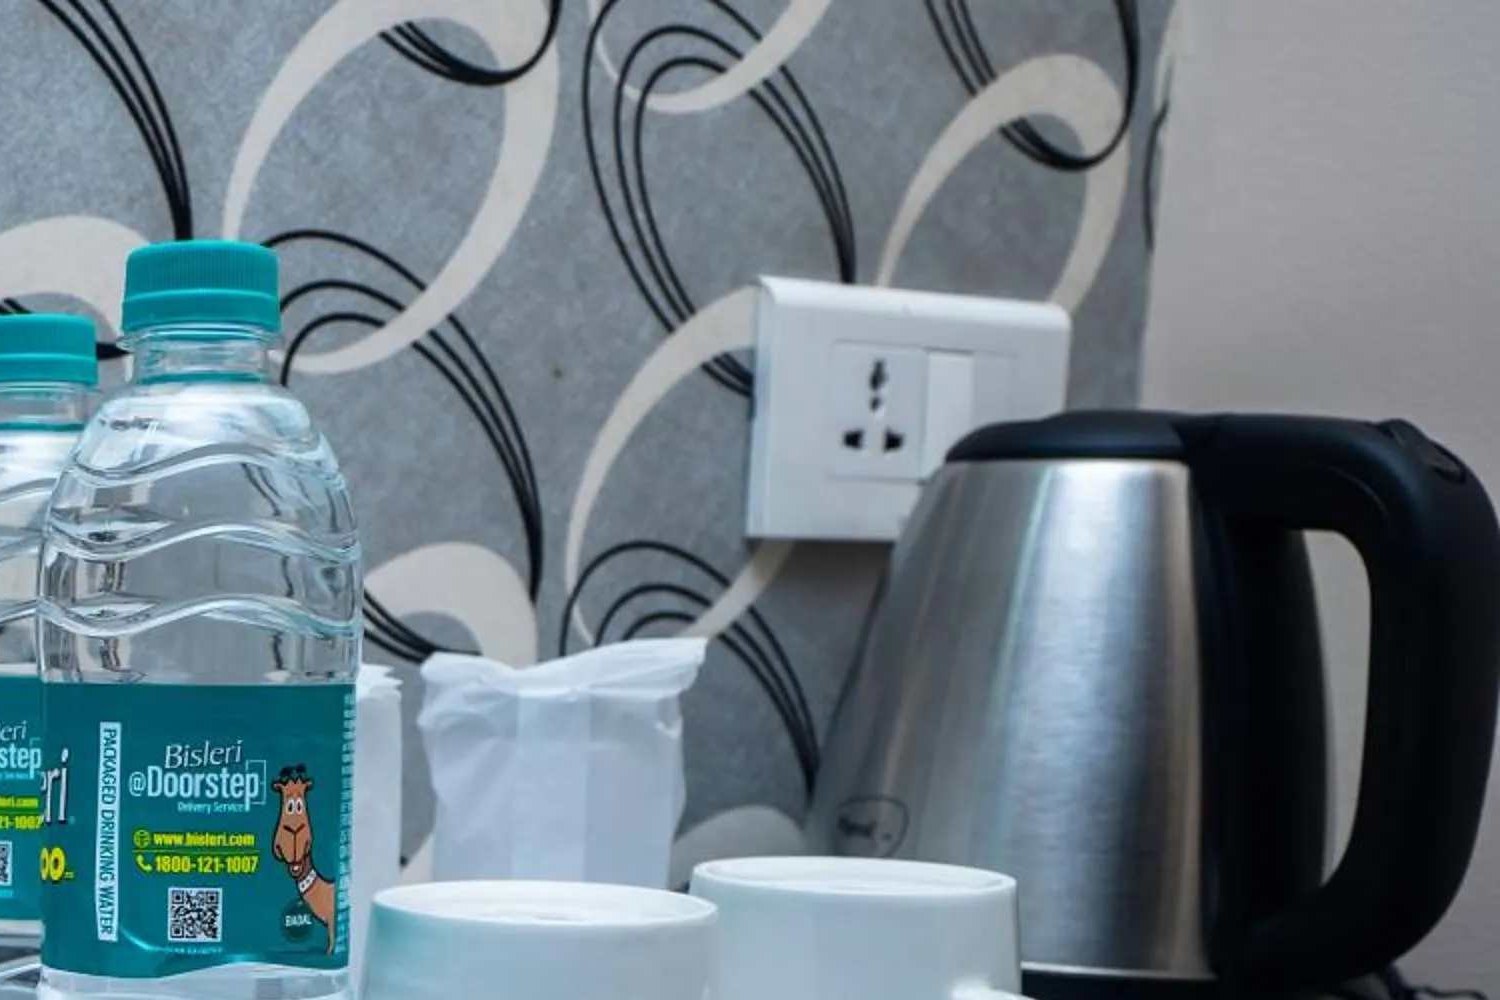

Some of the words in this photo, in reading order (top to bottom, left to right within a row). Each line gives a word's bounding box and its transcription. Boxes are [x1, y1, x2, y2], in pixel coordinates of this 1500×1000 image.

[101, 727, 117, 805] PACKAGED
[164, 739, 243, 769] Bisleri
[128, 765, 259, 812] @Doorstep
[177, 801, 211, 815] Delivery
[213, 801, 245, 813] Service
[99, 809, 116, 882] DRINKING
[153, 832, 255, 847] www.bisleri.com
[155, 855, 259, 873] 1800-121-1007
[98, 884, 115, 935] WATER
